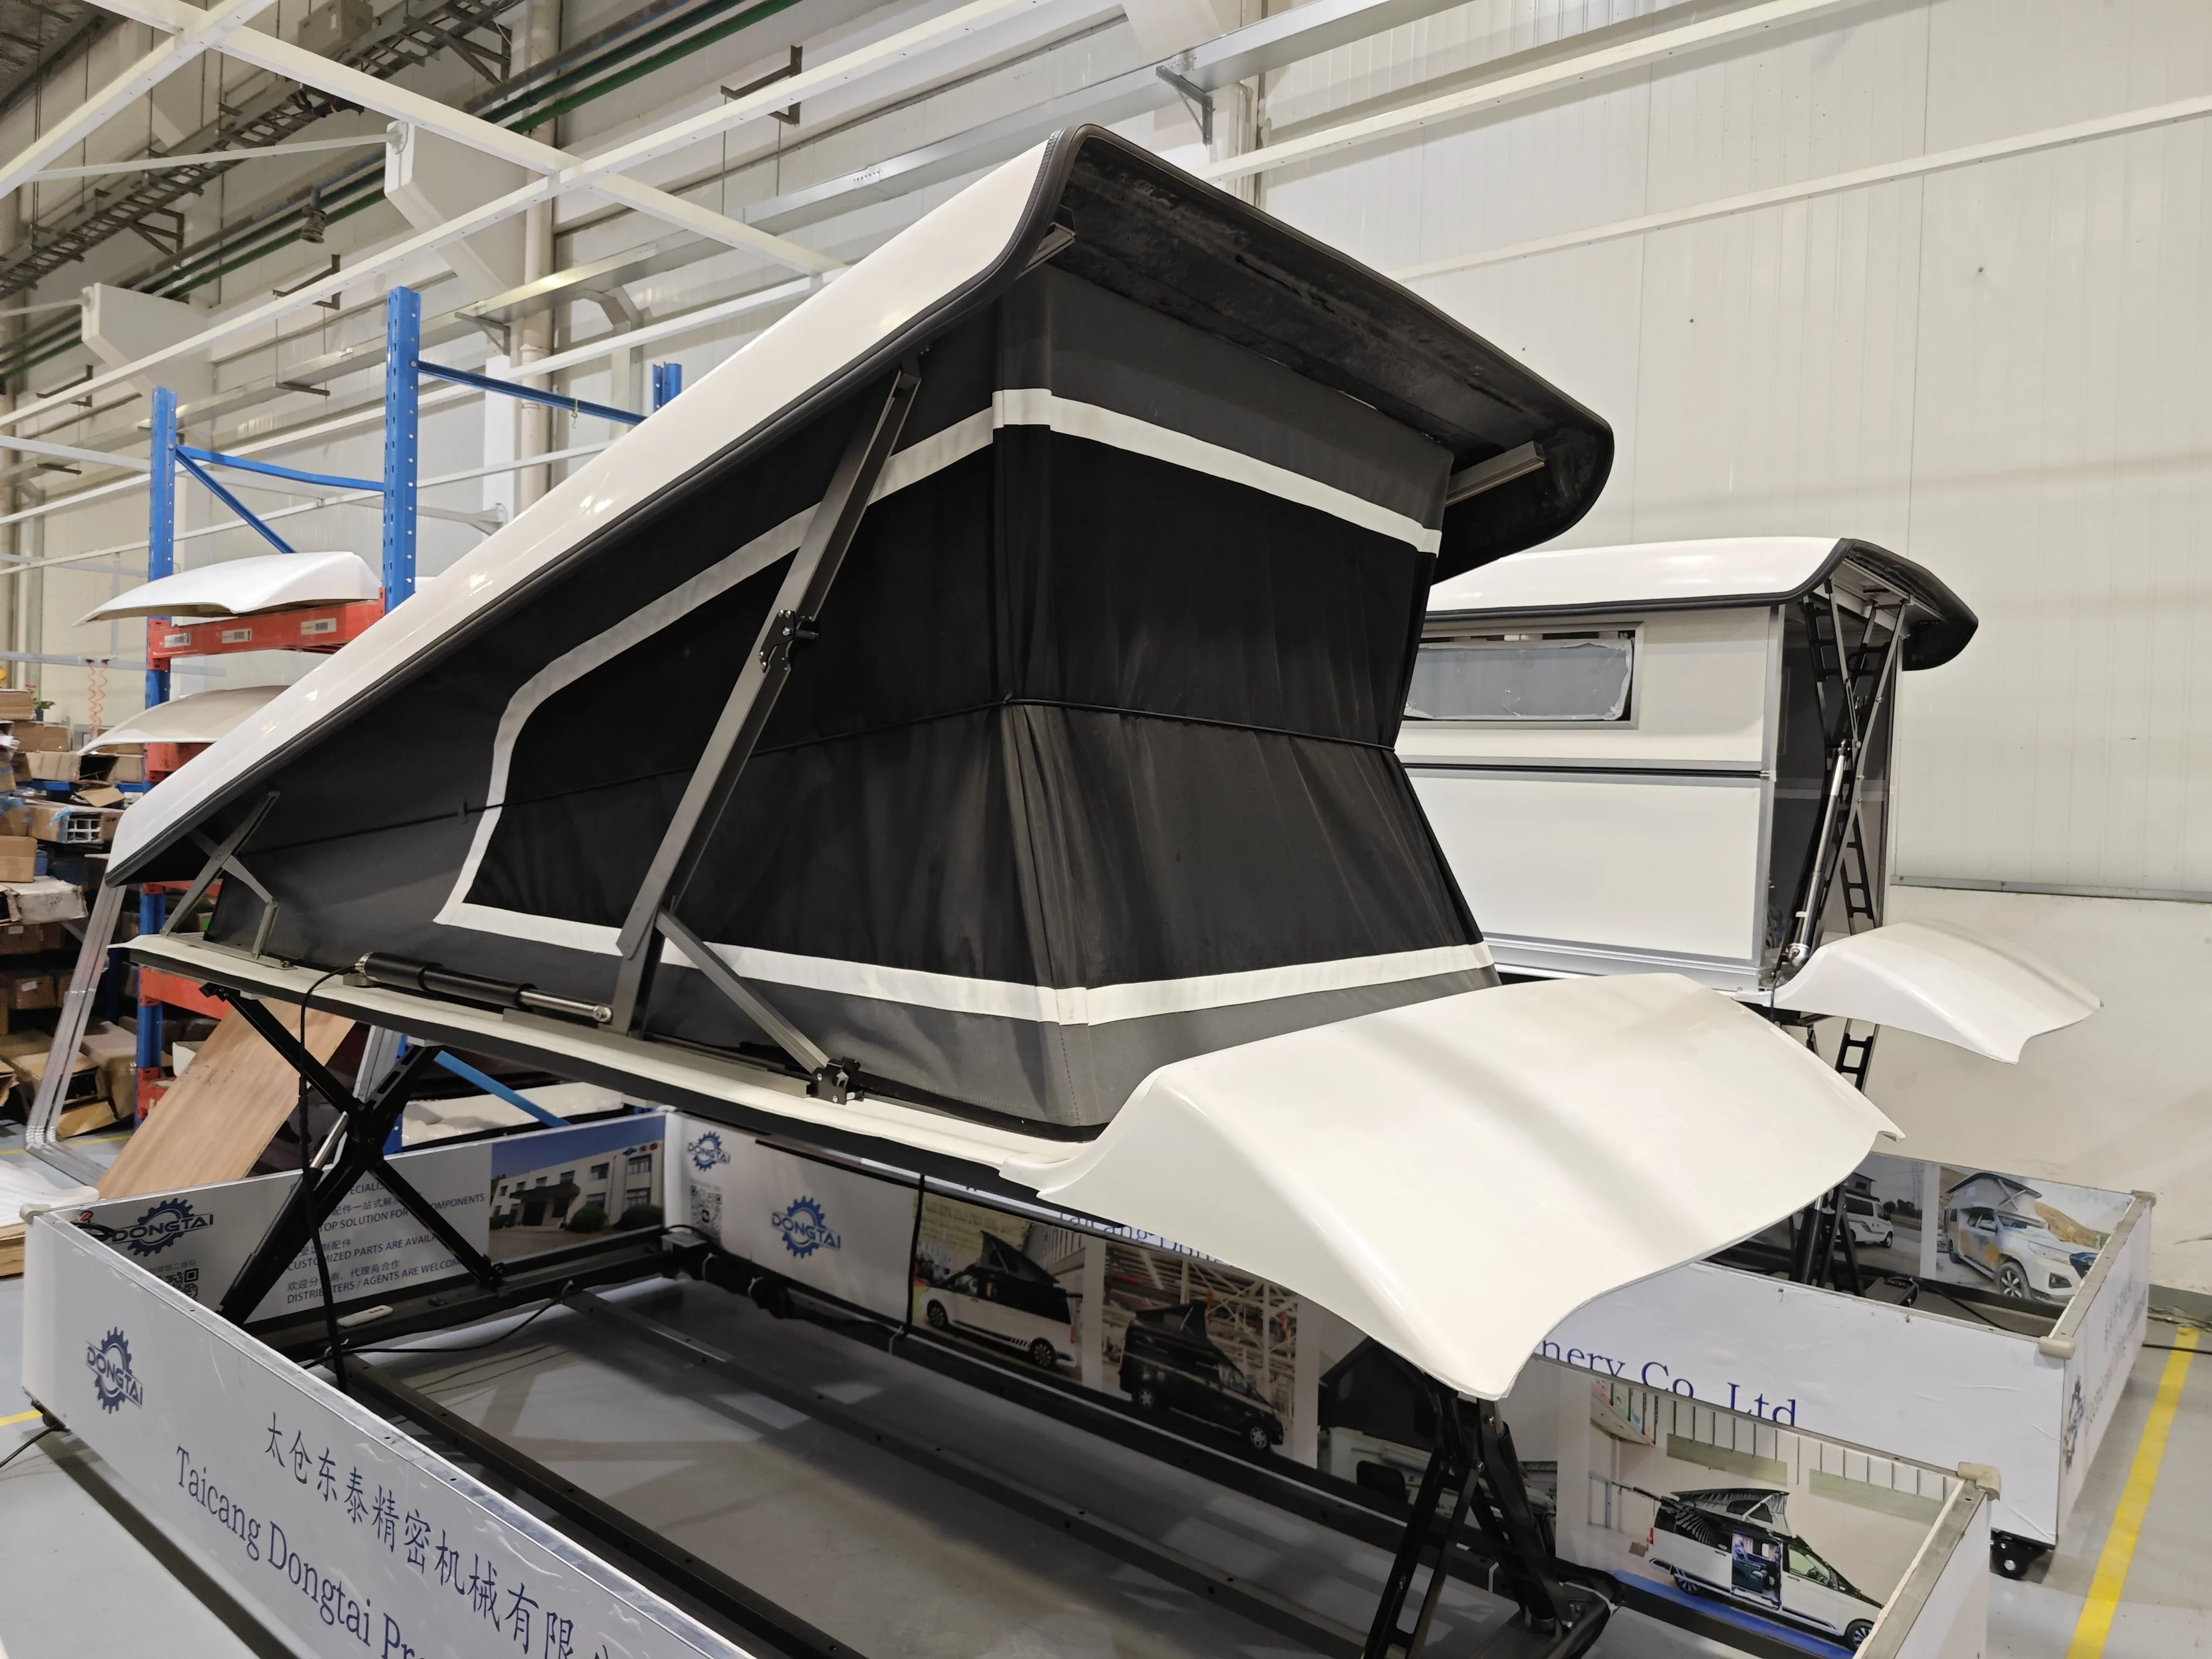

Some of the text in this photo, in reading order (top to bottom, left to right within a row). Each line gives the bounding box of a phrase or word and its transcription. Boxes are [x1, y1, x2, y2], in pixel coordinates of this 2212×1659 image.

[111, 1214, 214, 1243] DONGTAI
[340, 1212, 388, 1229] SOLUTION
[390, 1208, 409, 1219] FOR
[431, 1193, 485, 1210] OMPONENTS
[354, 1244, 383, 1257] PARTS
[386, 1239, 403, 1251] ARE
[405, 1235, 436, 1247] AVAIL
[771, 1212, 841, 1249] DONGTAI
[363, 1271, 399, 1286] AGENTS
[402, 1267, 419, 1278] ARE
[421, 1258, 460, 1273] WELCOM
[86, 1345, 143, 1406] DONGTAI
[1541, 1339, 1626, 1377] nery
[176, 1444, 261, 1562] Taicang
[267, 1521, 372, 1647] Dongtai
[264, 1411, 610, 1659] 太仓东泰精密机械有限
